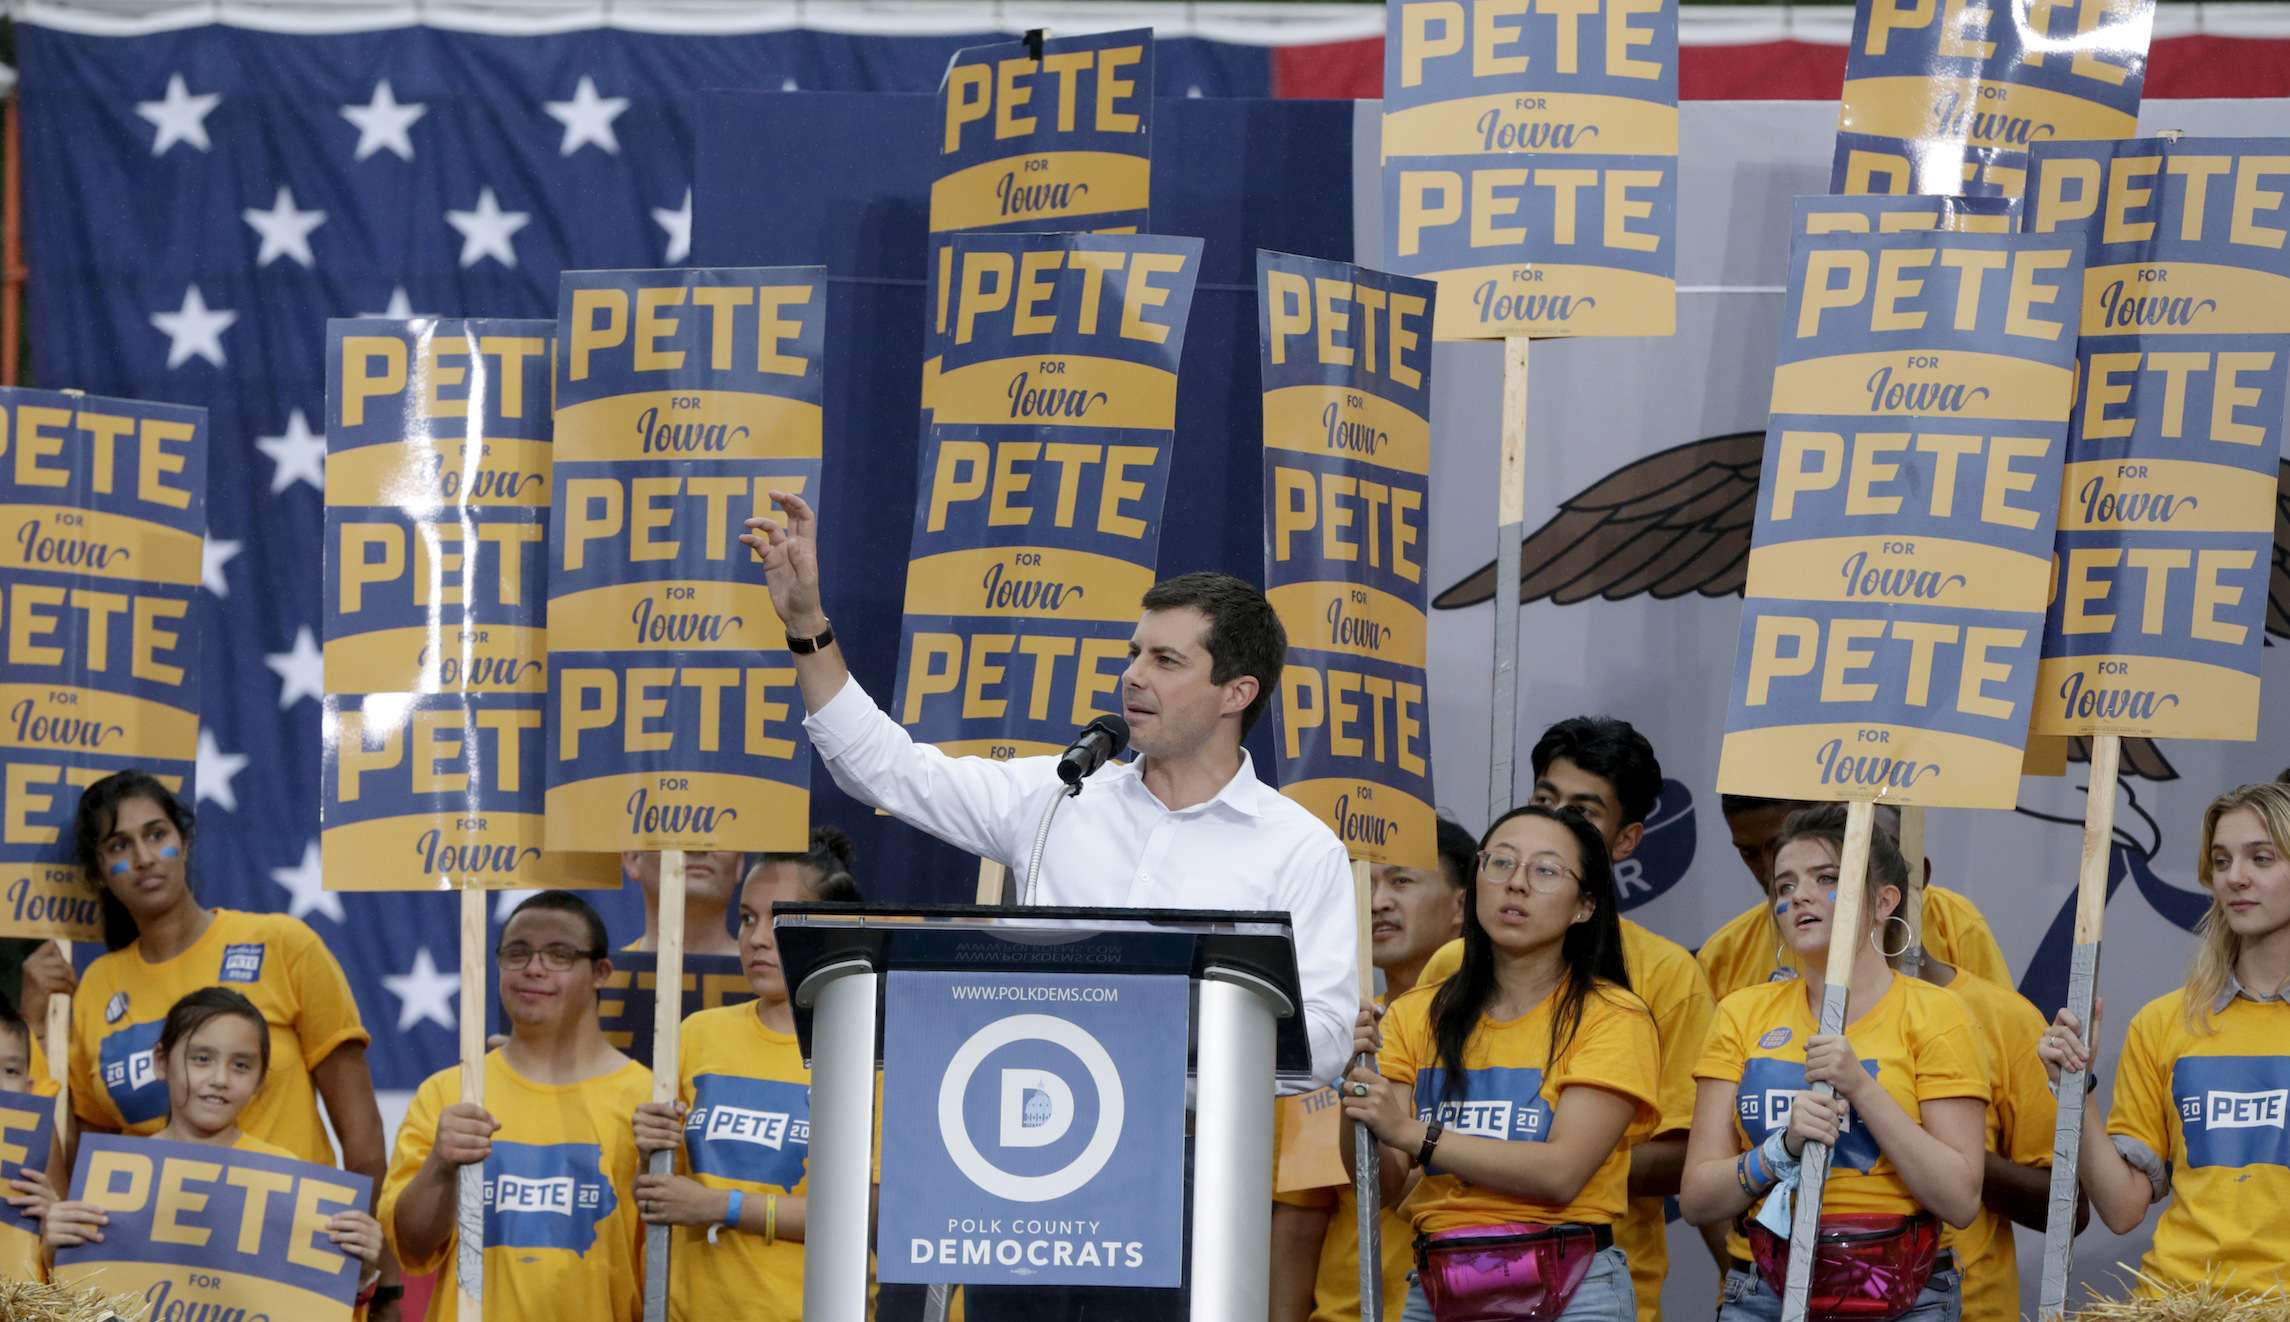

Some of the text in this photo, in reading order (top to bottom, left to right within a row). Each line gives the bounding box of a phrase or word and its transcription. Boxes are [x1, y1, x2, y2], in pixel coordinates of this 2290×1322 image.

[1401, 0, 1664, 88] PETE
[944, 45, 1143, 155] PETE
[1515, 98, 1547, 110] FOR
[1976, 86, 2008, 101] FOR
[1476, 108, 1599, 151] Iowa
[1933, 93, 2055, 145] Iowa
[1025, 159, 1049, 172] FOR
[996, 171, 1088, 216] Iowa
[1398, 168, 1664, 257] PETE
[2035, 155, 2290, 249] PETE
[955, 250, 1187, 346] PETE
[1512, 269, 1543, 282] FOR
[1796, 248, 2073, 341] PETE
[2138, 269, 2167, 282] FOR
[1473, 279, 1596, 323] Iowa
[2100, 280, 2217, 328] Iowa
[569, 284, 813, 381] PETE
[1267, 269, 1427, 391] PETE
[341, 335, 557, 427] PET
[1040, 361, 1065, 374] FOR
[1907, 356, 1939, 369] FOR
[671, 397, 701, 410] FOR
[1008, 372, 1107, 418] Iowa
[1347, 394, 1364, 410] FOR
[1866, 366, 1990, 412] Iowa
[2071, 351, 2276, 447] ETE
[460, 444, 491, 457] FR
[636, 407, 750, 454] Iowa
[1322, 401, 1388, 456] Iowa
[0, 405, 196, 509] ETE
[2118, 465, 2148, 478] FOR
[926, 440, 1160, 540] PETE
[1770, 430, 2052, 531] PETE
[2080, 476, 2198, 523] Iowa
[55, 514, 84, 527] FOR
[1274, 465, 1422, 585] PETE
[17, 519, 130, 569] Iowa
[1015, 553, 1042, 566] FOR
[1883, 542, 1915, 555] FOR
[339, 522, 543, 614] PET
[983, 562, 1084, 610] Iowa
[1841, 551, 1966, 599] Iowa
[666, 587, 695, 600] FOR
[1351, 590, 1368, 605] FOR
[2047, 548, 2258, 645] ETE
[0, 582, 189, 686] ETE
[457, 631, 489, 643] FOR
[632, 597, 743, 643] Iowa
[1327, 597, 1391, 650] Iowa
[902, 632, 1132, 727] PETE
[1745, 614, 2028, 720] PETE
[2098, 661, 2128, 675] FOR
[49, 692, 78, 705] FOR
[560, 667, 798, 761] PETE
[2060, 671, 2179, 719] Iowa
[10, 698, 123, 747] Iowa
[1280, 664, 1426, 779] PETE
[1857, 729, 1890, 743] FOR
[337, 709, 542, 803] PET
[990, 746, 1016, 759] FOR
[1816, 738, 1940, 788] Iowa
[659, 778, 689, 791] FOR
[1357, 786, 1373, 800] FOR
[456, 818, 488, 831] FOR
[626, 787, 738, 834] Iowa
[1335, 793, 1398, 846] Iowa
[416, 829, 542, 874] Iowa
[45, 870, 74, 883] FOR
[951, 986, 1118, 1002] WWW.POLKDEMS.COM
[107, 1066, 125, 1083] 20
[1000, 1068, 1075, 1147] D
[1301, 1089, 1337, 1115] THE
[1440, 1106, 1507, 1132] PETE
[1516, 1113, 1539, 1128] 20
[1741, 1101, 1759, 1114] 20
[2182, 1094, 2282, 1122] 20 PETE
[687, 1111, 810, 1142] 20 PETE 20
[78, 1150, 358, 1275] PETE
[500, 1180, 568, 1207] PETE
[578, 1190, 600, 1203] 20
[948, 1218, 1101, 1235] POLK COUNTY
[910, 1238, 1144, 1268] DEMOCRATS
[188, 1273, 222, 1290] FOR
